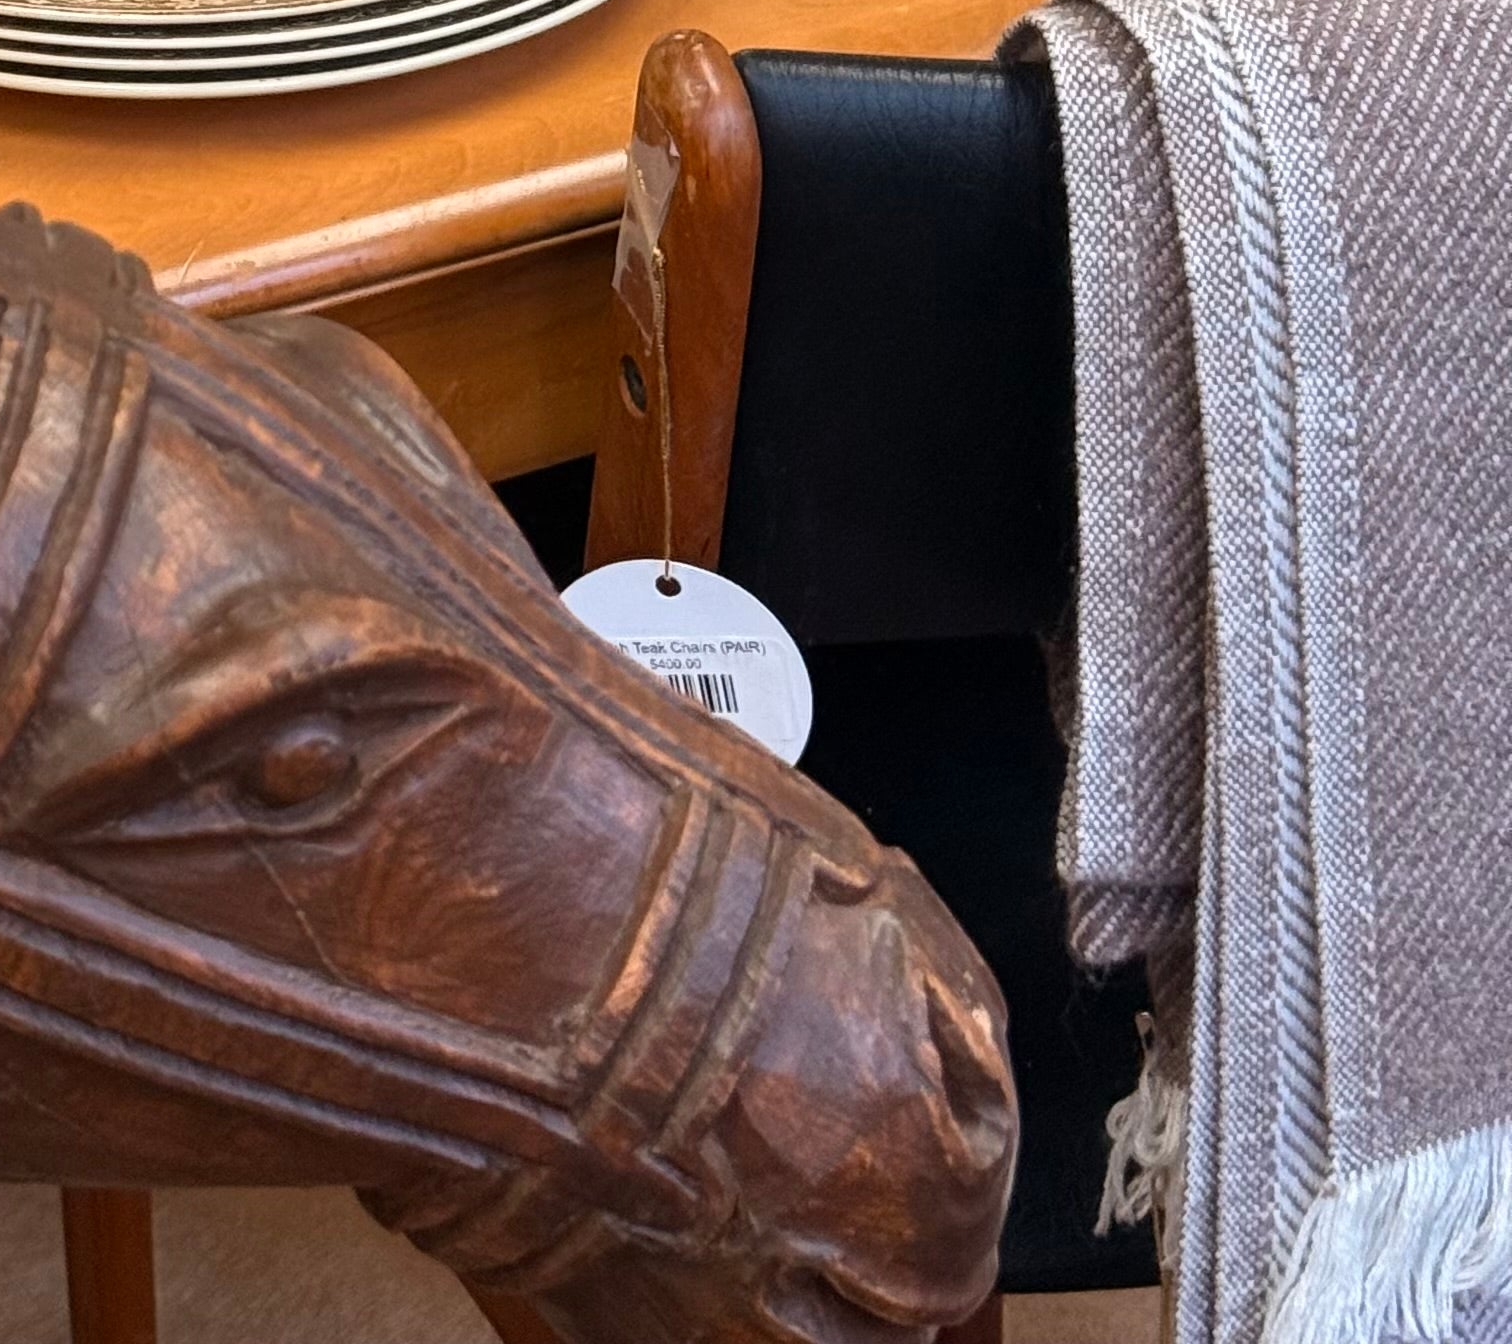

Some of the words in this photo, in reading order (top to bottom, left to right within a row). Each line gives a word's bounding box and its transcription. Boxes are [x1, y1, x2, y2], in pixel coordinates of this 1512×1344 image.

[633, 641, 667, 654] Teak
[670, 641, 716, 654] Chairs
[720, 640, 767, 656] (PAIR)
